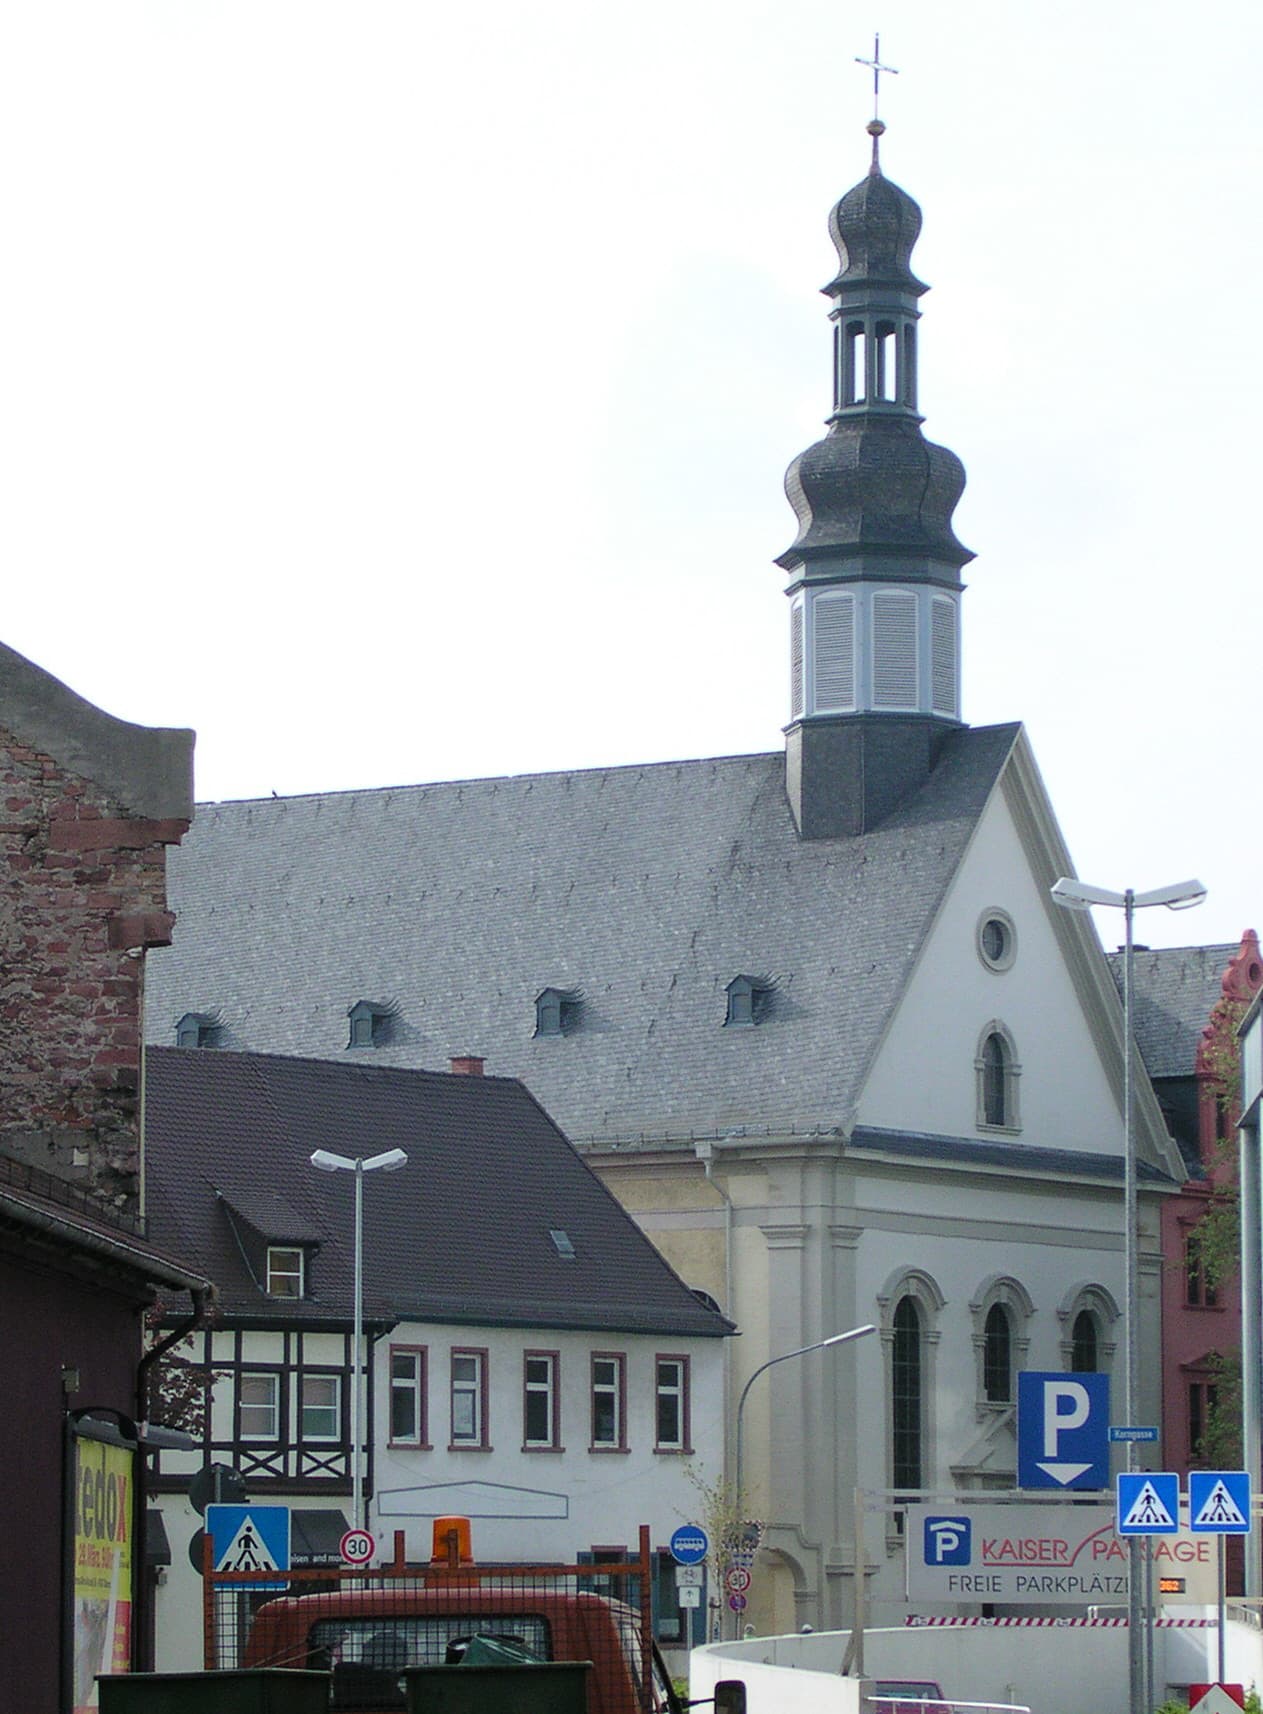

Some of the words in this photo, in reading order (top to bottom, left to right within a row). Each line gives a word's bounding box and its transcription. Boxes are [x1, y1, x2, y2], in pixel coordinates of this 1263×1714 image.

[1044, 1381, 1090, 1457] P
[348, 1539, 368, 1555] 30
[936, 1532, 960, 1562] P
[982, 1539, 1069, 1561] KAISER
[949, 1575, 1002, 1593] FREIE
[1016, 1572, 1129, 1594] PARKPLÄTZ
